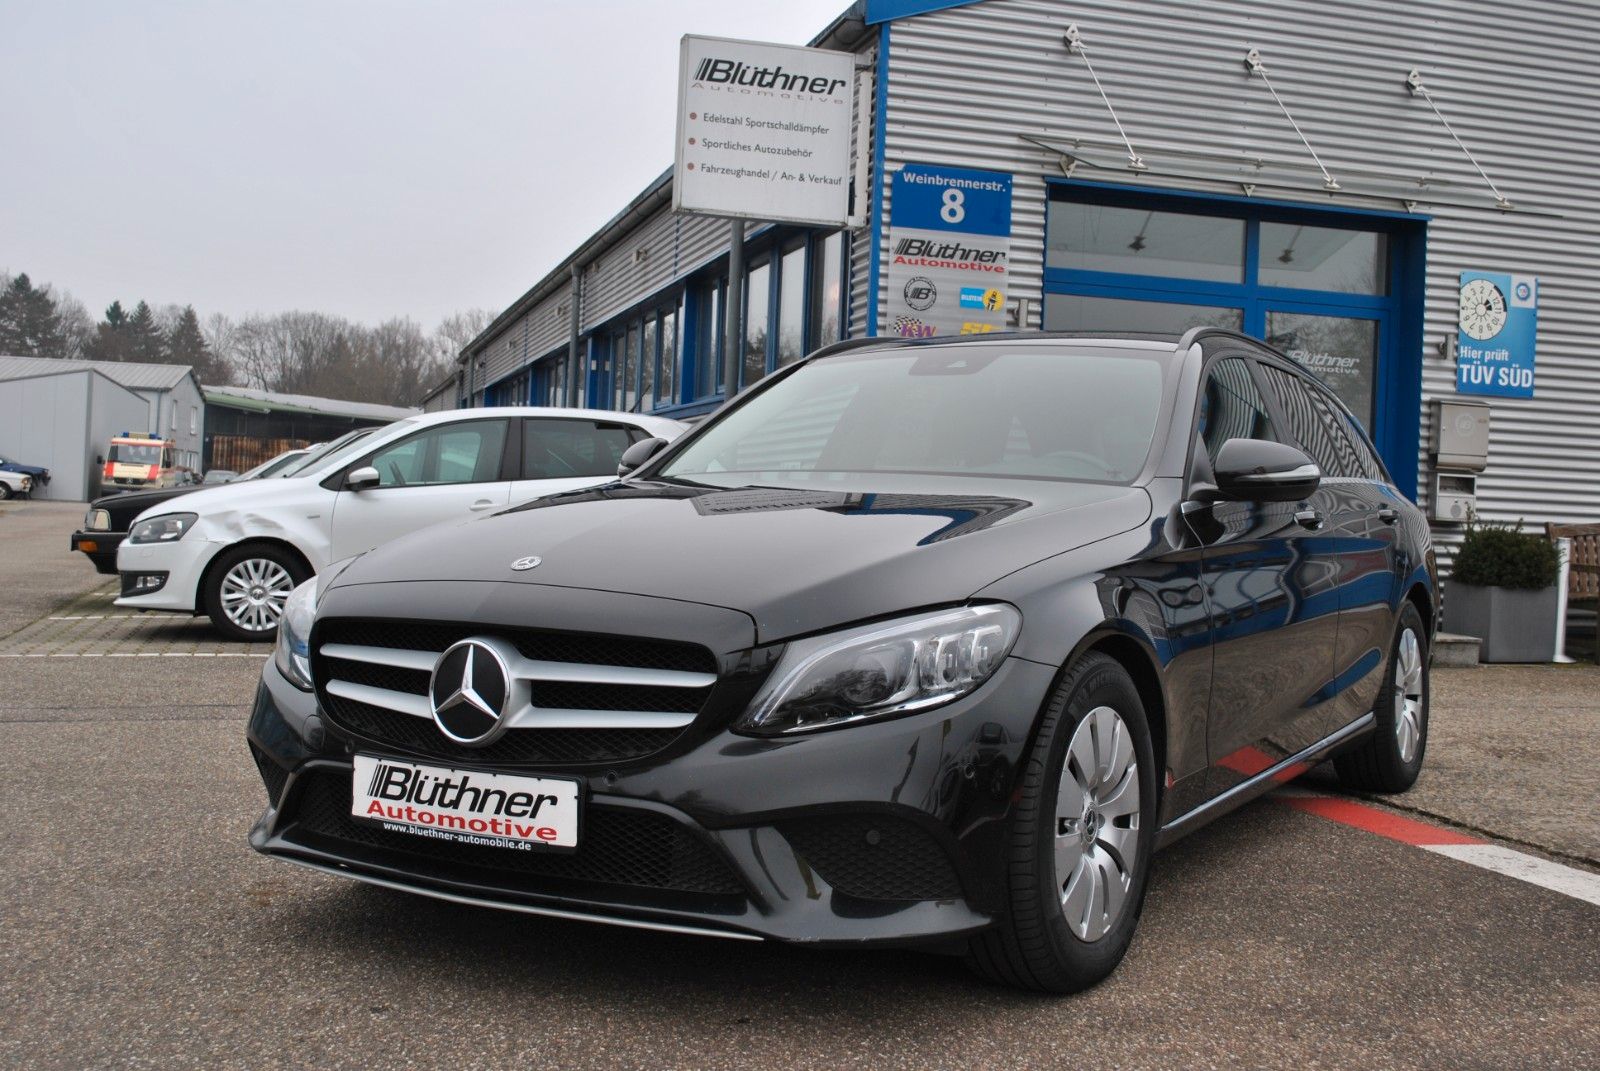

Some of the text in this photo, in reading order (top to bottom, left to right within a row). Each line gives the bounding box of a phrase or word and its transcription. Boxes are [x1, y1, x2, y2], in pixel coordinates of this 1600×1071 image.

[704, 58, 846, 95] Blüthner
[691, 82, 843, 105] Automotive
[703, 112, 830, 136] Edelstahl Sportschalldämpfer
[702, 138, 813, 158] Sportliches Autozubehör
[700, 163, 770, 179] Fahrzeughandel
[780, 171, 796, 181] An-
[798, 173, 806, 182] &
[808, 173, 842, 185] Verkauf
[903, 172, 1006, 192] Weinbrennerstr.
[940, 188, 965, 223] 8
[901, 238, 1006, 264] Blüthner
[893, 256, 1005, 273] Automotive
[1291, 350, 1360, 367] Blüthner
[1460, 346, 1509, 363] Hier prüft
[1306, 364, 1360, 375] omotive
[1459, 361, 1533, 388] TÜV SÜD
[377, 765, 559, 819] Blüthner
[366, 799, 558, 841] Automotive
[383, 821, 532, 850] www.bluethner-automobile.de
